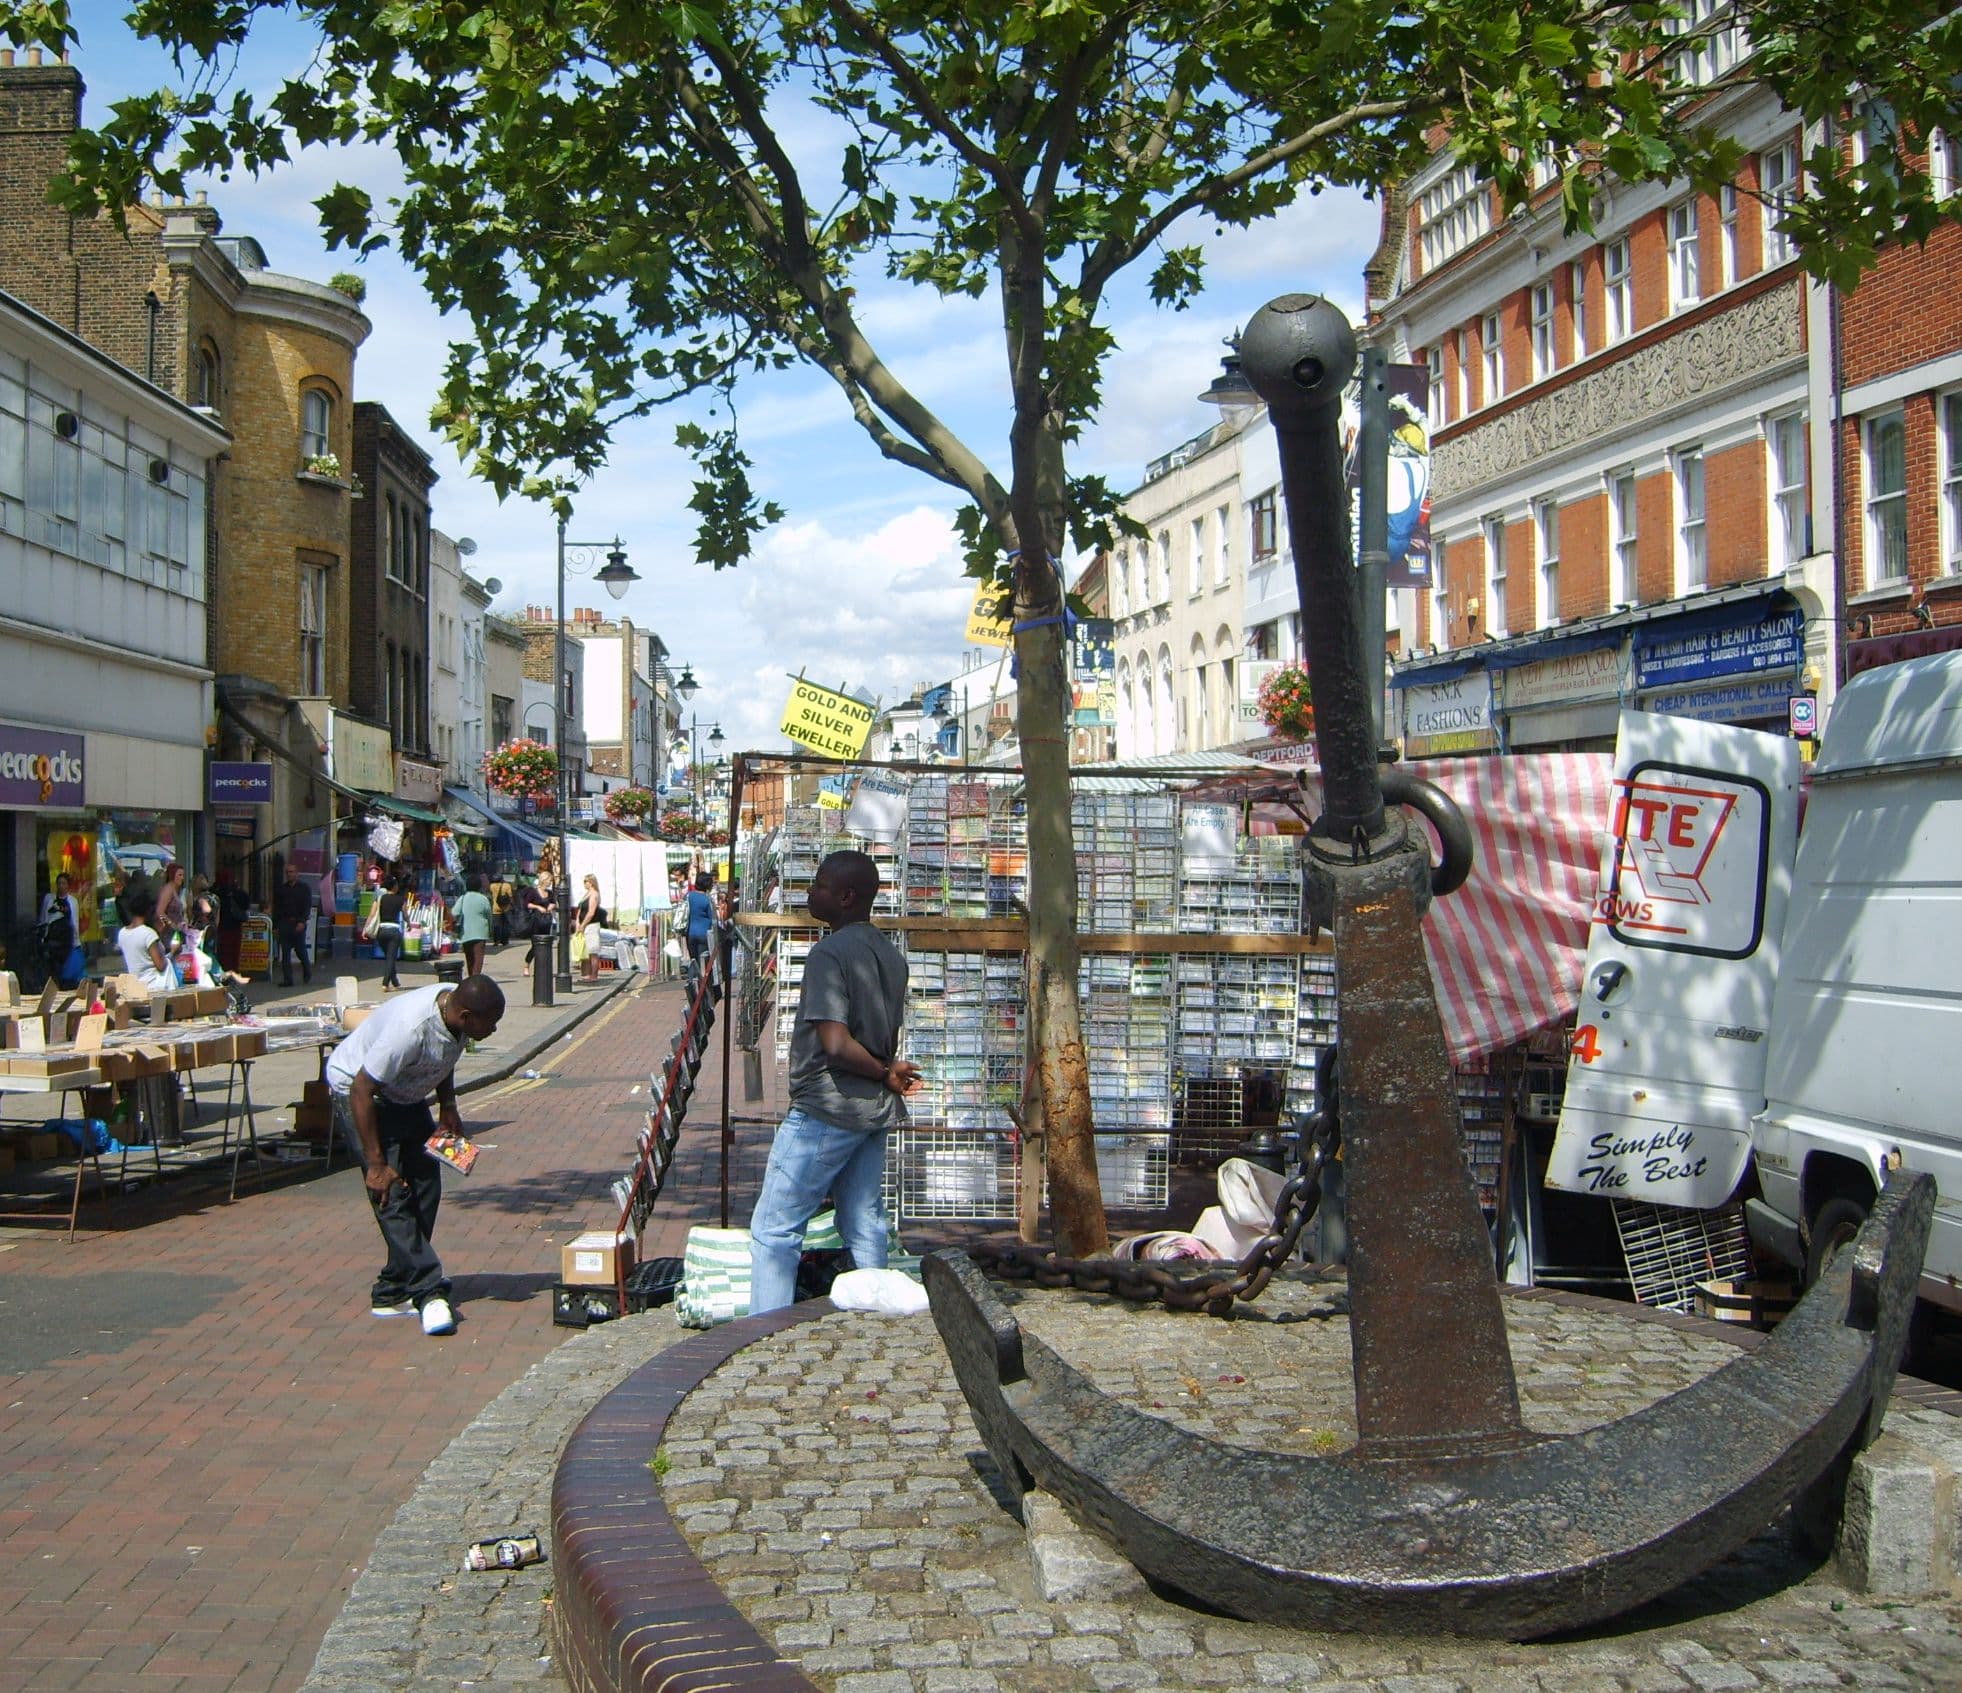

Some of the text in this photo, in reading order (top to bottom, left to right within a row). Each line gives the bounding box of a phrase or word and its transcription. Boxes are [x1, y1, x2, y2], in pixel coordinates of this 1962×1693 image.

[971, 626, 1010, 641] JEWE
[1685, 635, 1708, 653] HAIR
[1711, 632, 1719, 648] &
[1721, 624, 1757, 646] BEAUTY
[1760, 617, 1794, 639] SALON
[1747, 637, 1792, 655] ACCESSORIES
[796, 686, 871, 723] GOLD AND
[1654, 681, 1794, 712] CHEAP INTERNATIONAL CALLS
[800, 708, 854, 737] SILVER
[1242, 707, 1258, 717] TO
[1416, 705, 1481, 732] FASHIONS
[780, 722, 860, 759] JEWELLERY
[1252, 743, 1313, 761] DEPTFORD
[0, 750, 82, 793] eacocks
[215, 778, 268, 789] peacocks
[861, 776, 876, 789] Are
[876, 781, 901, 799] Empty
[820, 798, 840, 810] GOLD
[1184, 817, 1199, 827] Are
[1200, 817, 1225, 830] Empty
[1586, 1125, 1696, 1160] Simply
[1578, 1156, 1708, 1191] The Best
